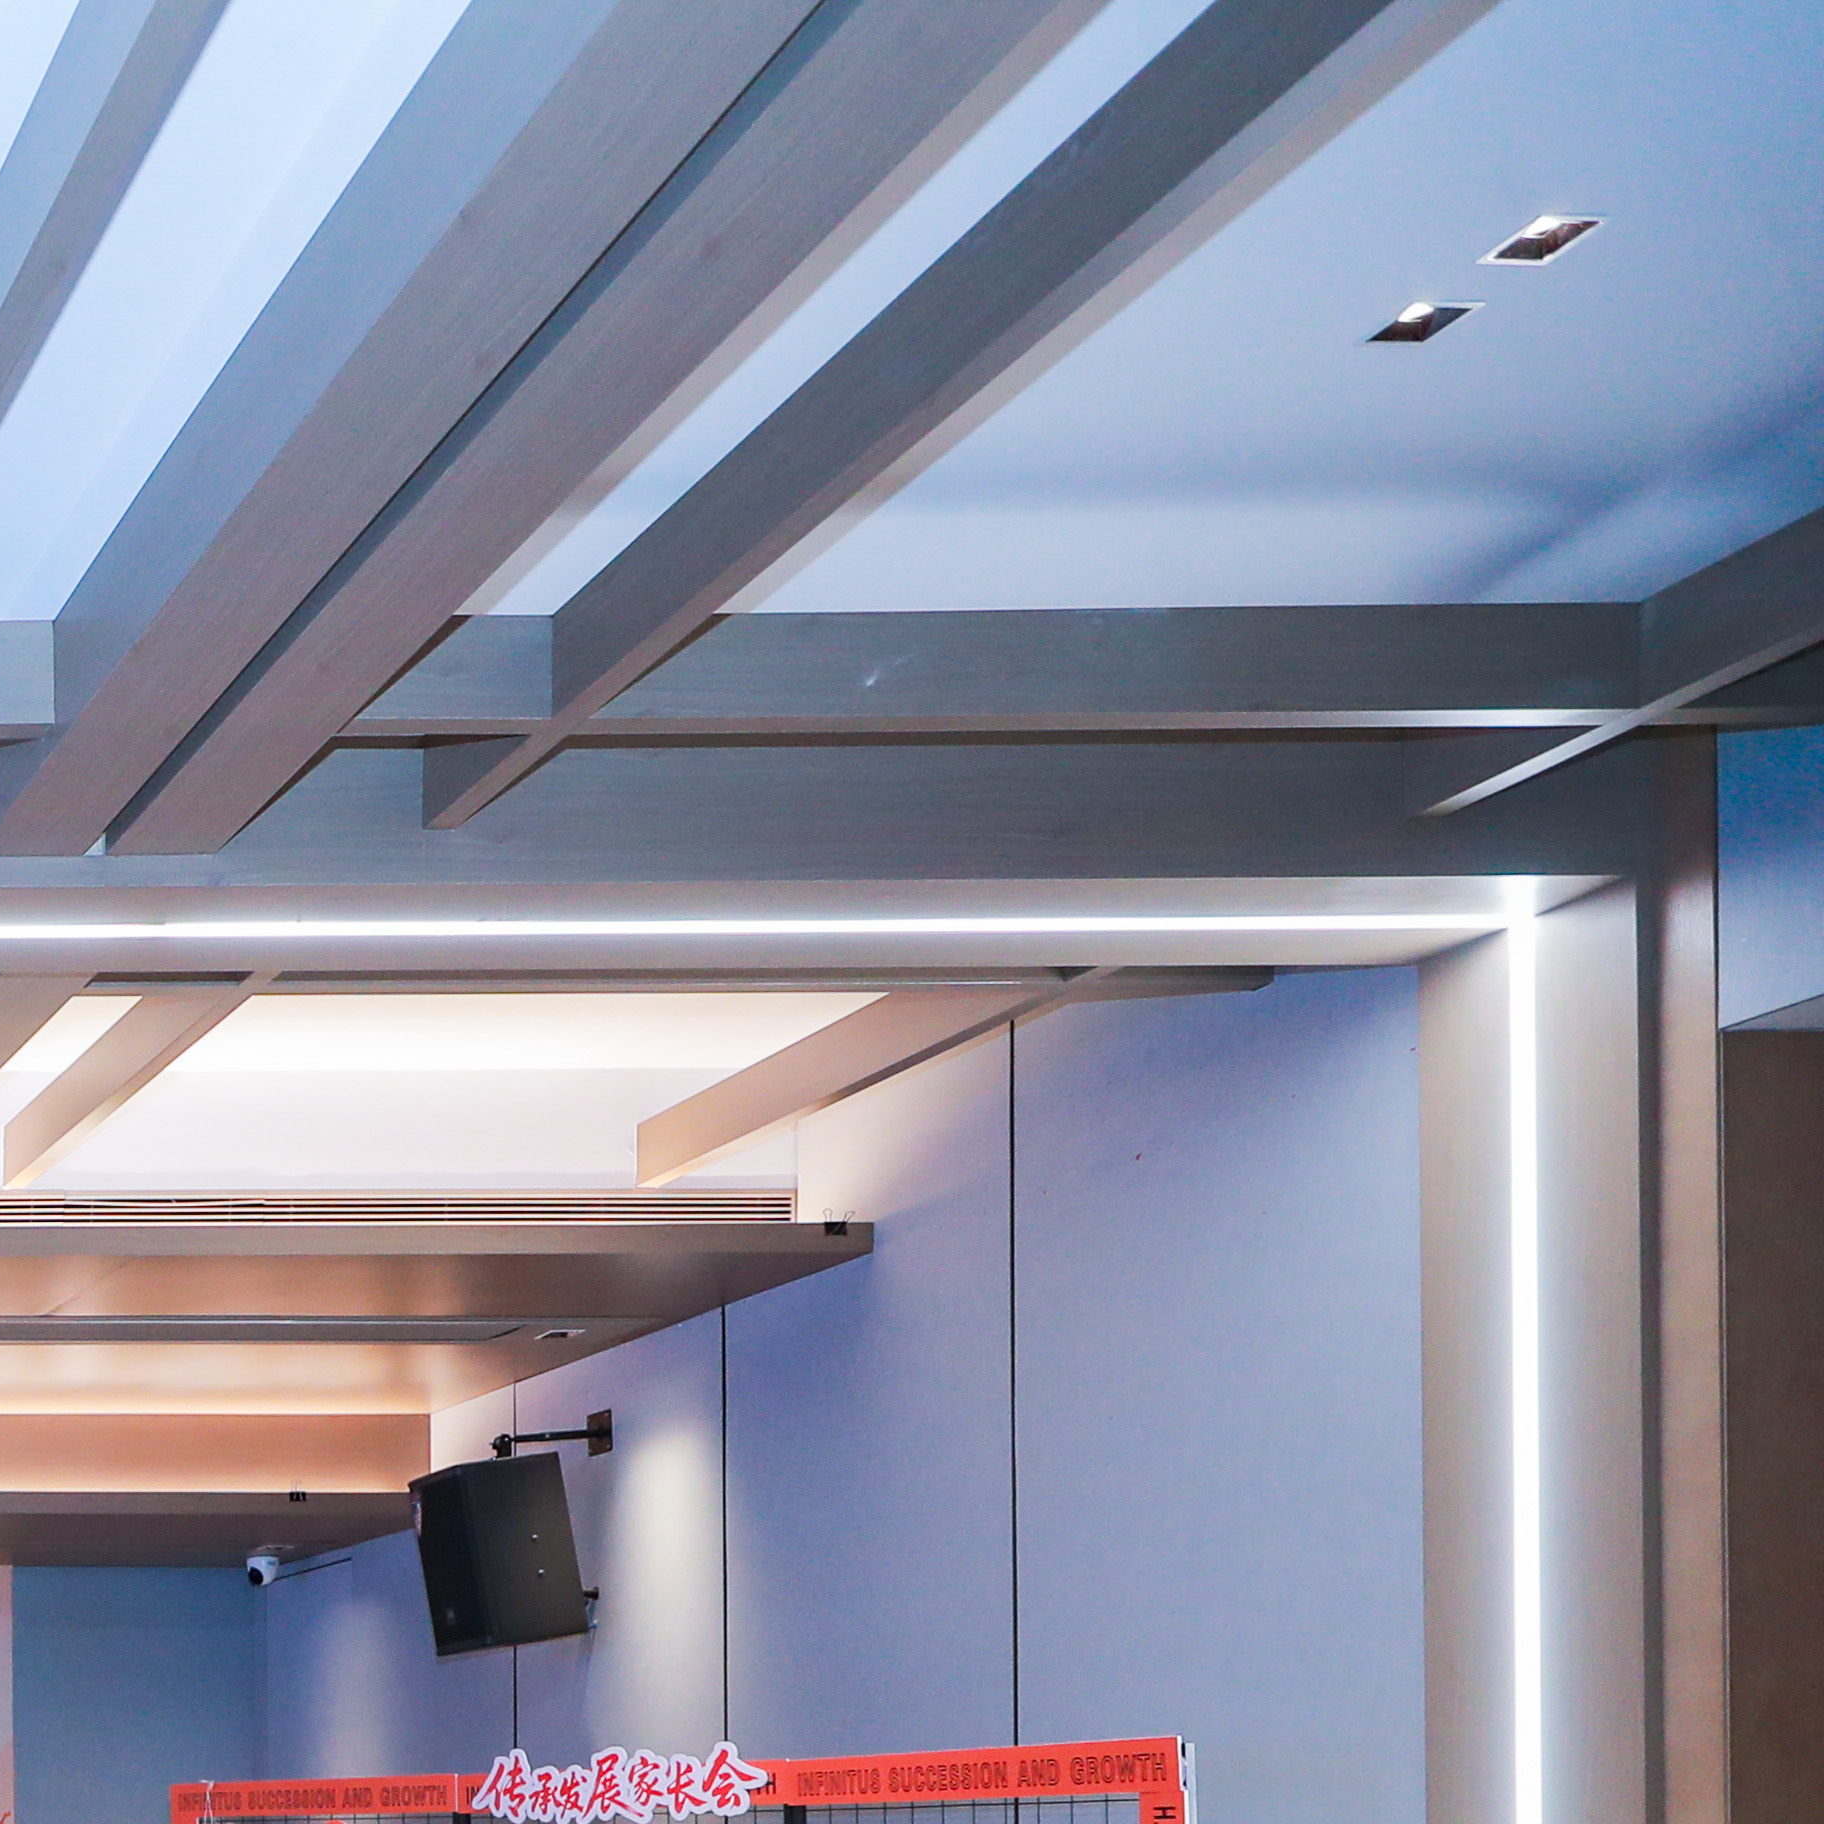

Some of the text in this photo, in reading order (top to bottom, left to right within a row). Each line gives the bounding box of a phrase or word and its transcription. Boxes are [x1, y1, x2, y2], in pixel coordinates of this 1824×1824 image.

[248, 1788, 336, 1809] SUCCESSION
[343, 1787, 373, 1807] AND
[380, 1785, 447, 1806] GROWTH
[480, 1749, 760, 1822] 传承发展家长会
[797, 1768, 881, 1797] INFINITUS
[889, 1761, 1008, 1793] SUCCESSION
[1017, 1758, 1060, 1788] AND
[1071, 1753, 1168, 1784] GROWTH
